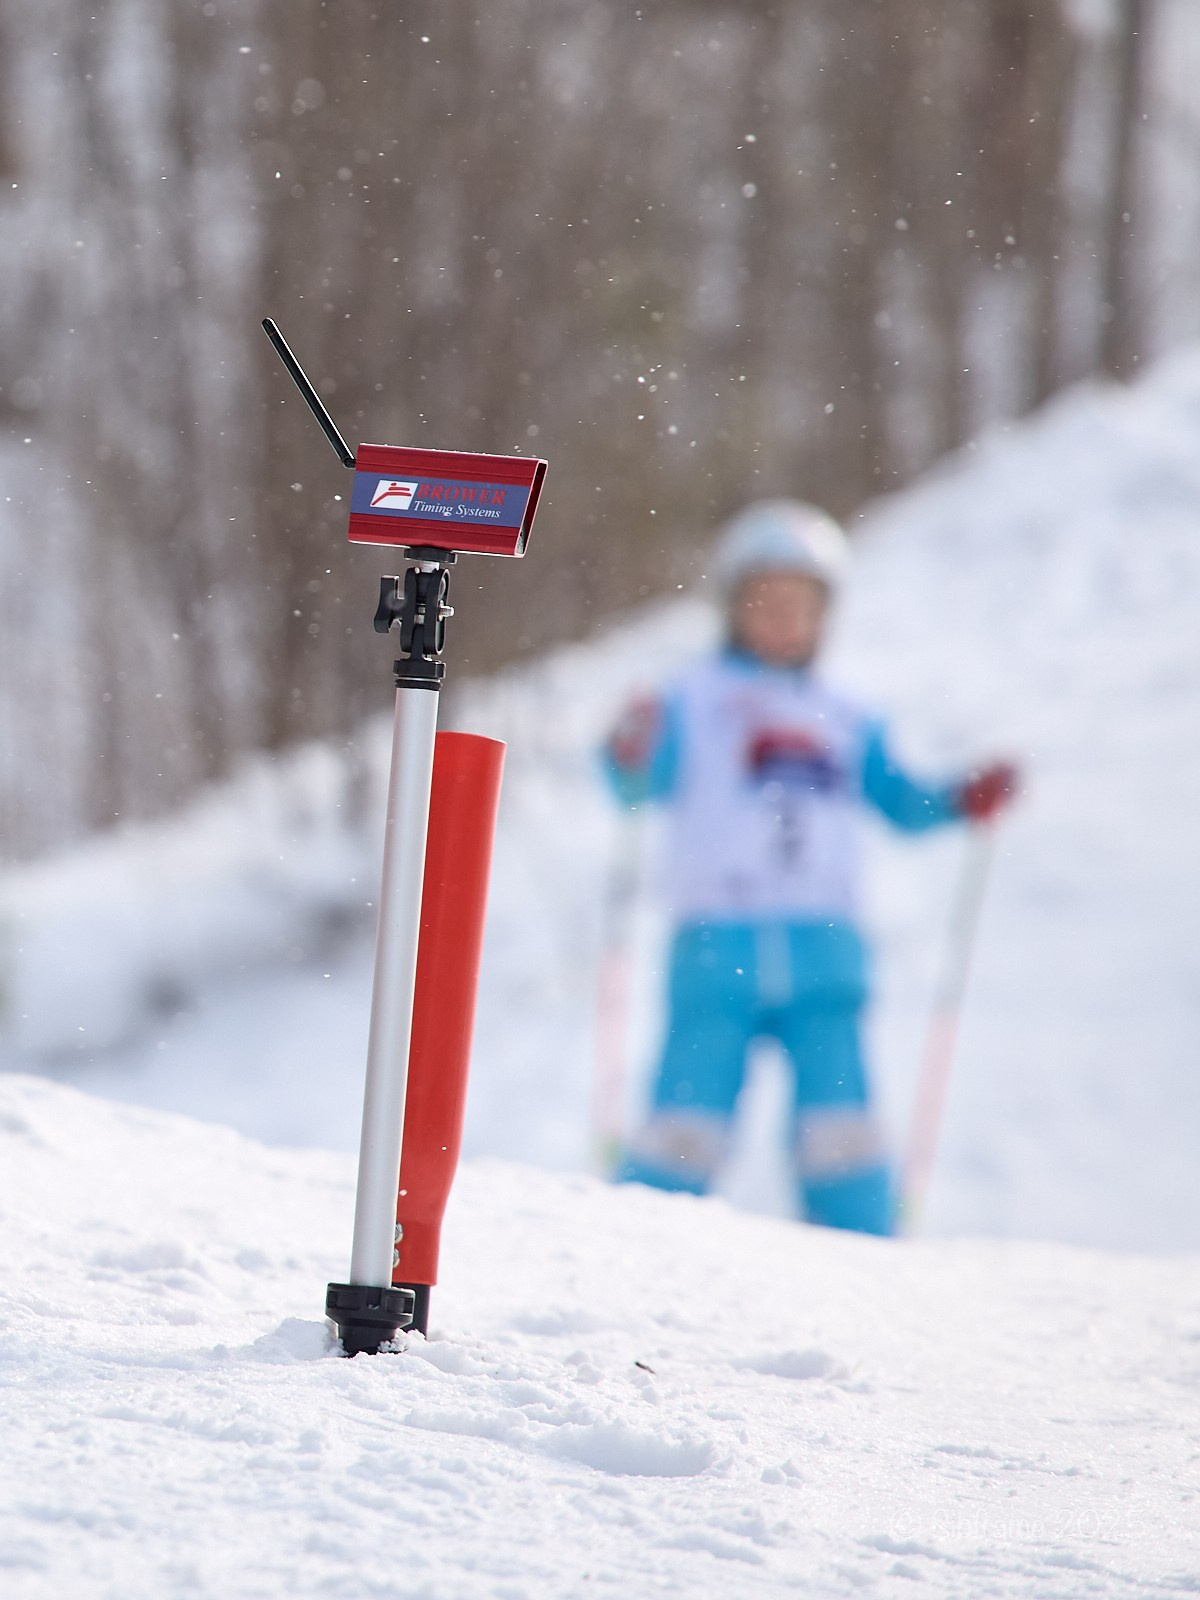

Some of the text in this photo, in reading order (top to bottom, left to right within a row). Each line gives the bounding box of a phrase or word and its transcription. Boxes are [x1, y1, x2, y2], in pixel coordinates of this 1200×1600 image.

[417, 484, 507, 505] BROWER
[414, 500, 500, 518] Timing Systems
